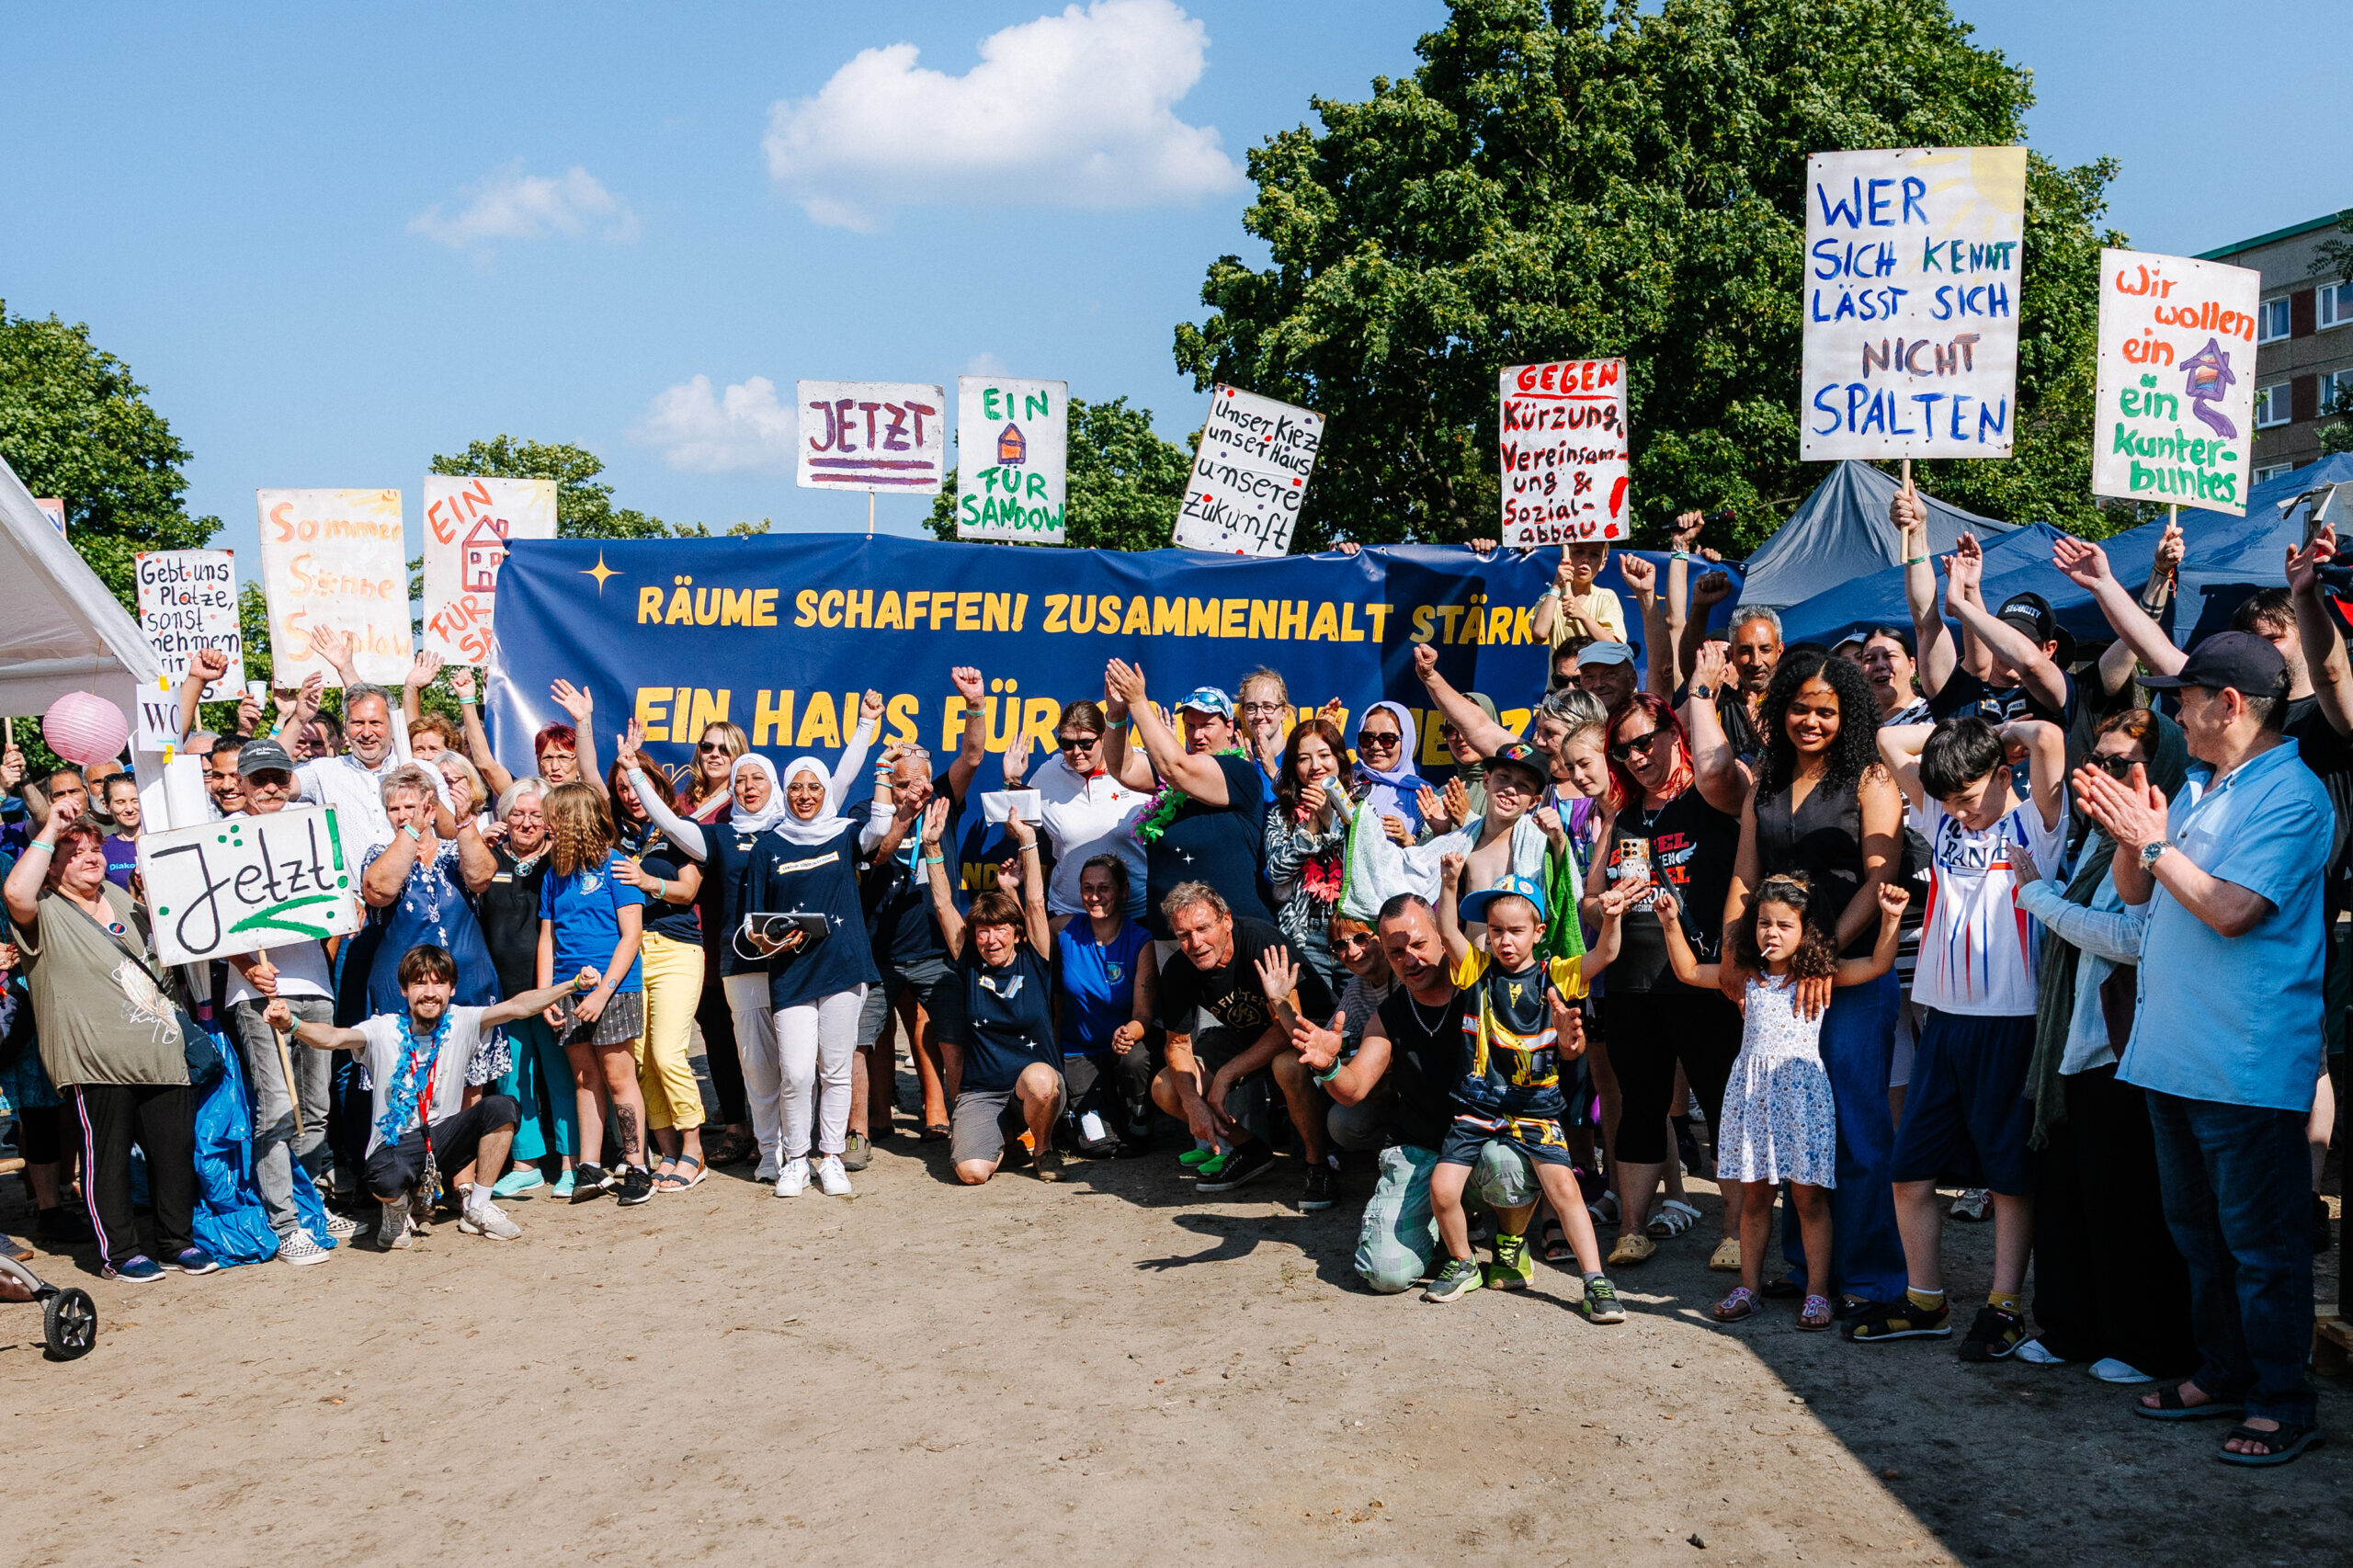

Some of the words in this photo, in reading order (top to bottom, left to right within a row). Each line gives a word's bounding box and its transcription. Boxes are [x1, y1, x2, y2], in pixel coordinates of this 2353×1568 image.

[1816, 176, 1929, 229] WER
[1812, 238, 1897, 280] SICH
[1922, 235, 2018, 274] KENNT
[2115, 263, 2178, 299] Wir
[1812, 283, 1908, 323] LÄSST
[1929, 281, 2009, 321] SICH
[2154, 301, 2256, 343] wollen
[1862, 333, 1981, 379] NICHT
[2121, 326, 2175, 367] ein
[1517, 361, 1619, 394] GEGEN
[2120, 372, 2179, 422] ein
[983, 387, 1050, 421] EIN
[1503, 399, 1625, 439] Kürzung,
[1812, 382, 2006, 443] SPALTEN
[809, 398, 936, 453] JETZT
[1215, 399, 1274, 436] Unser
[1274, 414, 1319, 453] Kiez
[1208, 426, 1270, 459] unser
[1268, 442, 1312, 477] Haus
[1501, 439, 1629, 473] Vereinsam-
[976, 464, 1049, 501] FÜR
[1198, 458, 1300, 511] unsere
[1513, 471, 1558, 497] ung
[1573, 470, 1593, 496] &
[269, 501, 403, 543] Sommer
[427, 479, 494, 545] EIN
[961, 493, 1065, 532] SANDOW
[1503, 497, 1596, 527] Sozial-
[1518, 519, 1597, 544] abbau
[141, 557, 188, 585] Gebt
[194, 562, 230, 582] uns
[160, 584, 234, 610] Plätze,
[637, 574, 779, 627] RÄUME
[793, 589, 1029, 632] SCHAFFEN!
[1042, 593, 1394, 643] ZUSAMMENHALT
[1409, 594, 1551, 645] STÄRK
[2005, 603, 2042, 619] SECURITY
[147, 607, 204, 632] sonst
[427, 595, 492, 644] FÜR
[150, 631, 240, 653] nehmen
[161, 654, 186, 673] ir
[142, 702, 180, 735] WC
[634, 687, 732, 744] EIN
[752, 688, 919, 748] HAUS
[941, 677, 1062, 755] FÜR
[108, 861, 136, 871] Diako
[150, 808, 348, 955] Jetzt!
